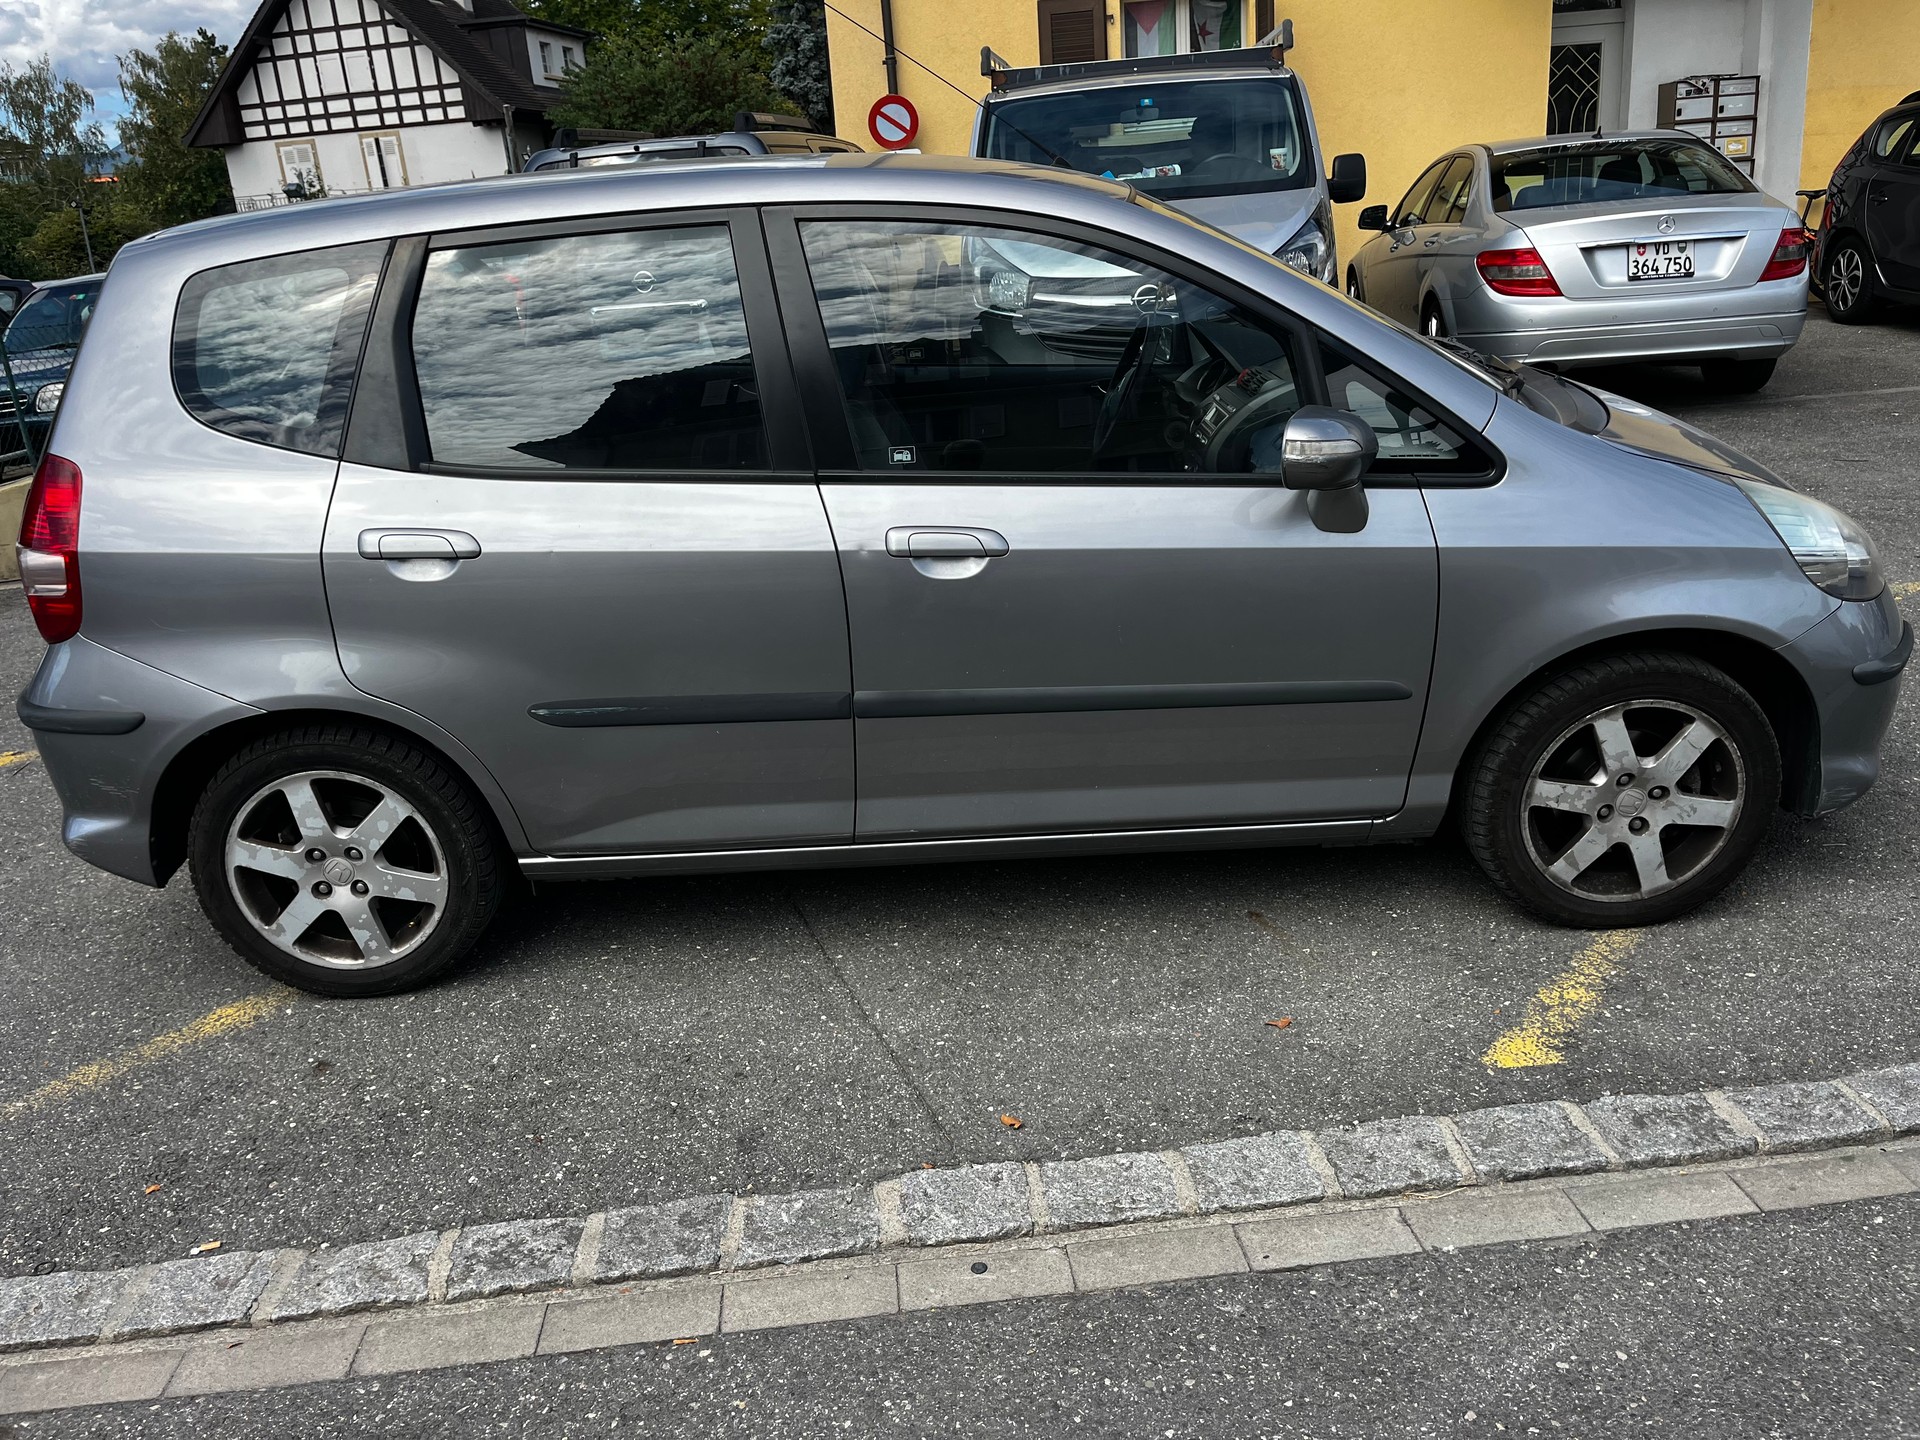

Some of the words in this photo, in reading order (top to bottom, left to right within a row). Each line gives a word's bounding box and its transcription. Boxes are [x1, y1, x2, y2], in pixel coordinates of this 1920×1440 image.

[1654, 242, 1670, 256] VD
[1631, 258, 1660, 276] 364
[1664, 256, 1692, 274] 750
